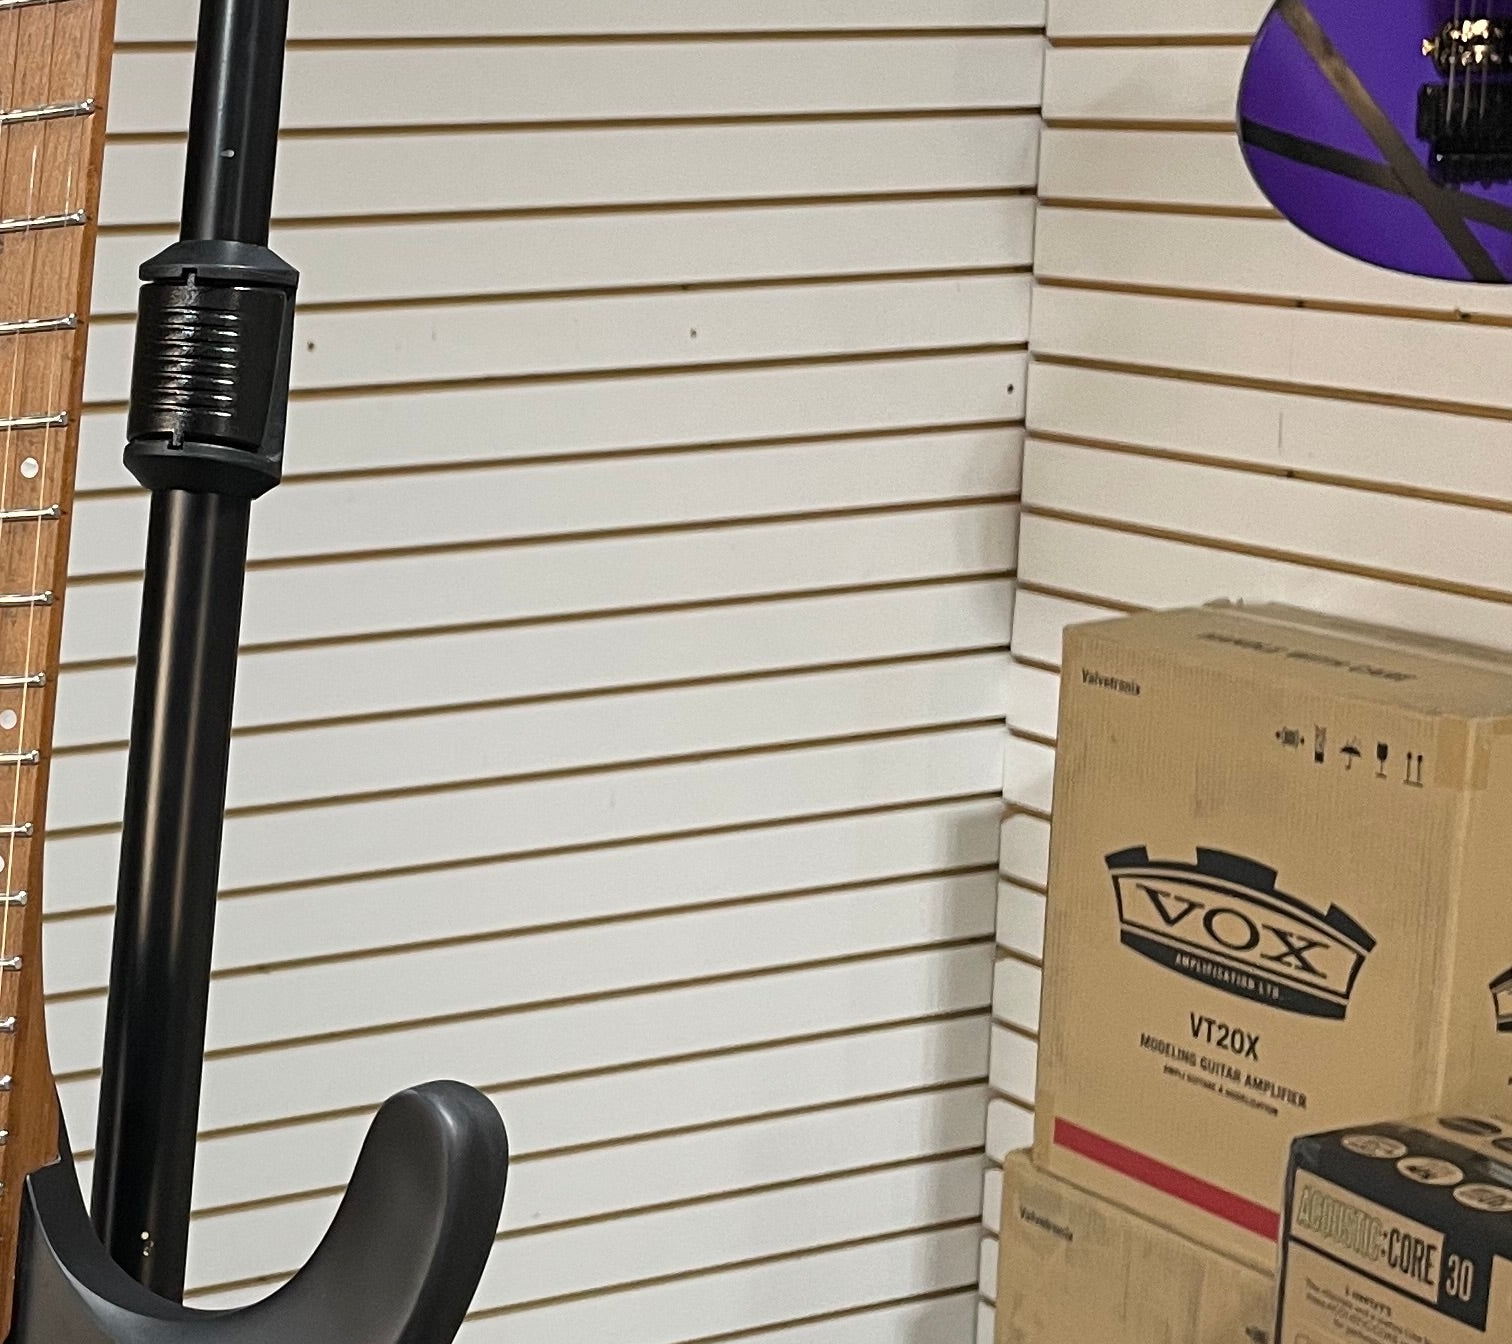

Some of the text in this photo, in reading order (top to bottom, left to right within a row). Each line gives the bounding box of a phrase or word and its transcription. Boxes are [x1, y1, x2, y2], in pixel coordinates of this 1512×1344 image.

[1136, 882, 1330, 980] VOX
[1190, 1011, 1260, 1061] VT20X
[1140, 1032, 1197, 1067] MODELING
[1199, 1055, 1241, 1082] GUITAR
[1244, 1073, 1307, 1111] AMPLIFIER
[1445, 1253, 1474, 1302] 30
